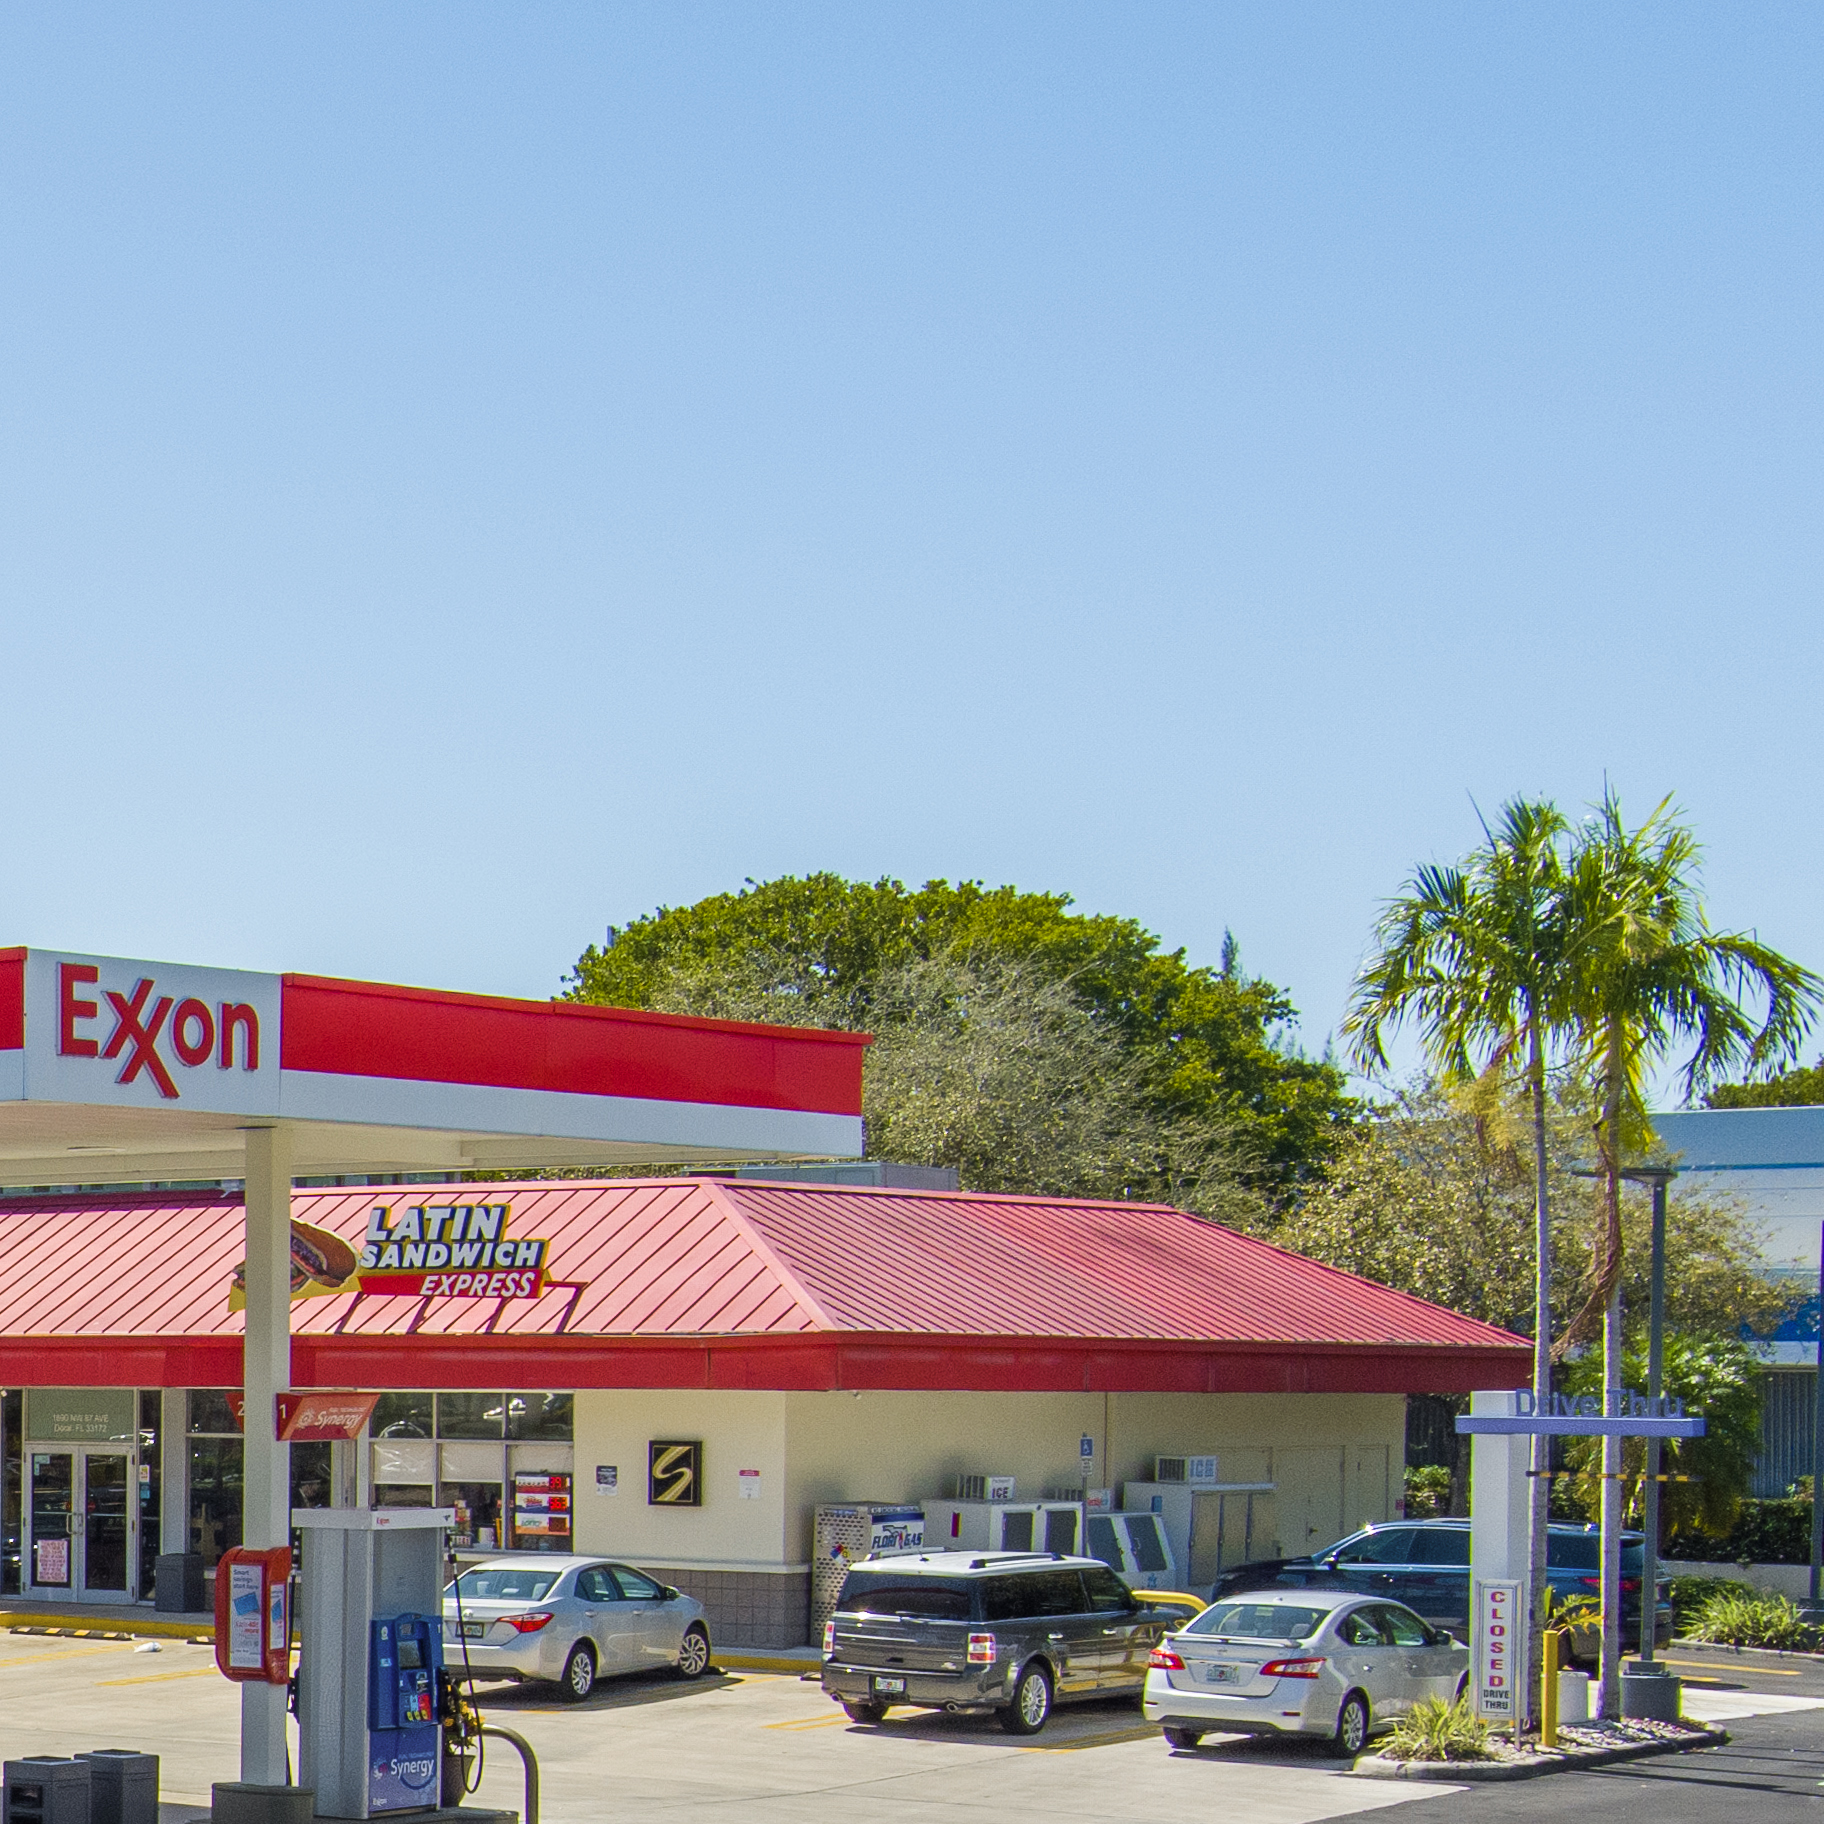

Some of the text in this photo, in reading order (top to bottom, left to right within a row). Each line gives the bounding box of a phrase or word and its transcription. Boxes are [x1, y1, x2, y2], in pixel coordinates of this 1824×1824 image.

[56, 962, 260, 1099] Exxon
[365, 1204, 509, 1242] LATIN
[360, 1240, 545, 1269] SANDWICH
[419, 1271, 536, 1298] EXPRESS
[237, 1402, 244, 1416] 2
[279, 1404, 287, 1418] 1
[1516, 1388, 1685, 1418] Drive Thru
[94, 1414, 109, 1423] AVE
[315, 1410, 363, 1430] Synergy
[85, 1424, 108, 1433] 33172
[1189, 1457, 1216, 1478] ICE
[991, 1487, 1010, 1499] ICE
[1489, 1591, 1505, 1687] CLOSED
[1483, 1689, 1510, 1699] DRIVE
[1485, 1699, 1509, 1710] THRU
[390, 1758, 435, 1777] Synergy
